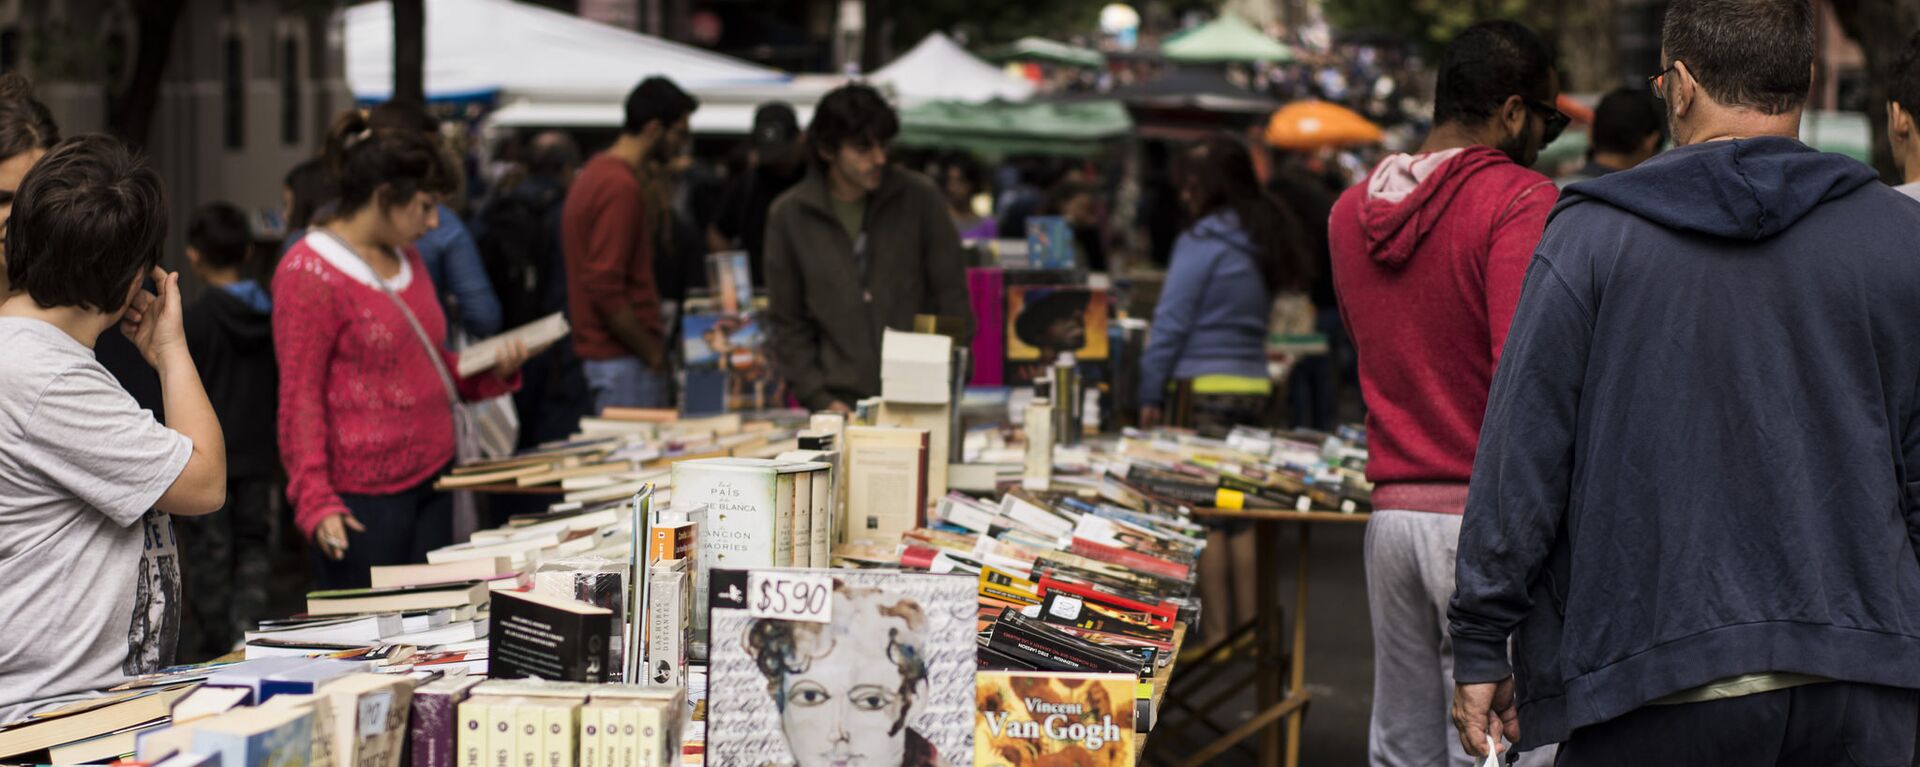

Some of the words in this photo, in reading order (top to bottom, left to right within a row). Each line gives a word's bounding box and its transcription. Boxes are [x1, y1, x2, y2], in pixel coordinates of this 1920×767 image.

[710, 487, 740, 497] PAÍS
[719, 502, 756, 512] BLANCA
[704, 530, 751, 540] ANCIÓN
[757, 578, 827, 614] $590
[1024, 696, 1082, 714] Vincent
[984, 710, 1040, 738] Van
[1044, 714, 1120, 750] Gogh
